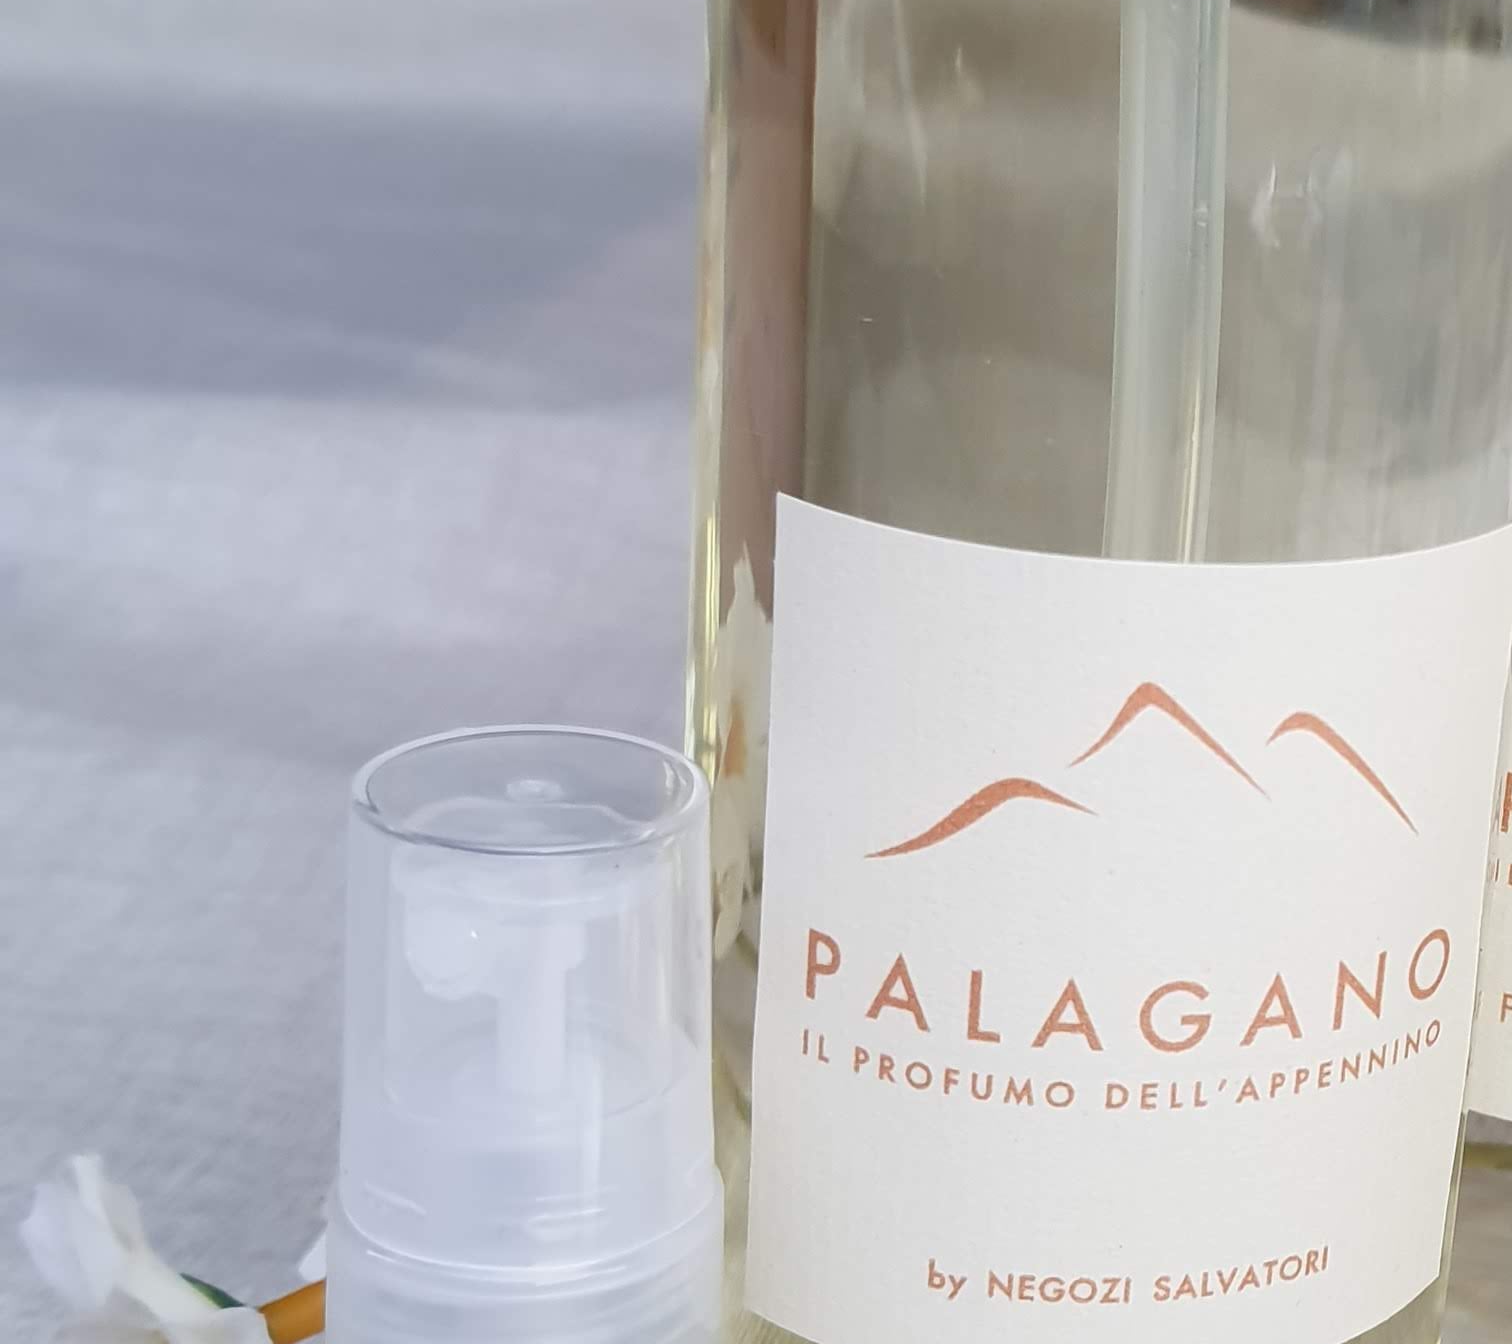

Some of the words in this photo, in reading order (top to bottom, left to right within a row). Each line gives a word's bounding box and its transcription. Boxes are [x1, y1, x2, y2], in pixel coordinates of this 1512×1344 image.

[806, 928, 1450, 1052] PALAGANO
[803, 1029, 829, 1063] IL
[854, 1046, 1074, 1107] PROFUMO
[1105, 1020, 1440, 1110] DELL'APPENNINO
[928, 1259, 967, 1300] by
[988, 1271, 1131, 1304] NEGOZI
[1154, 1246, 1328, 1301] SALVATORI
